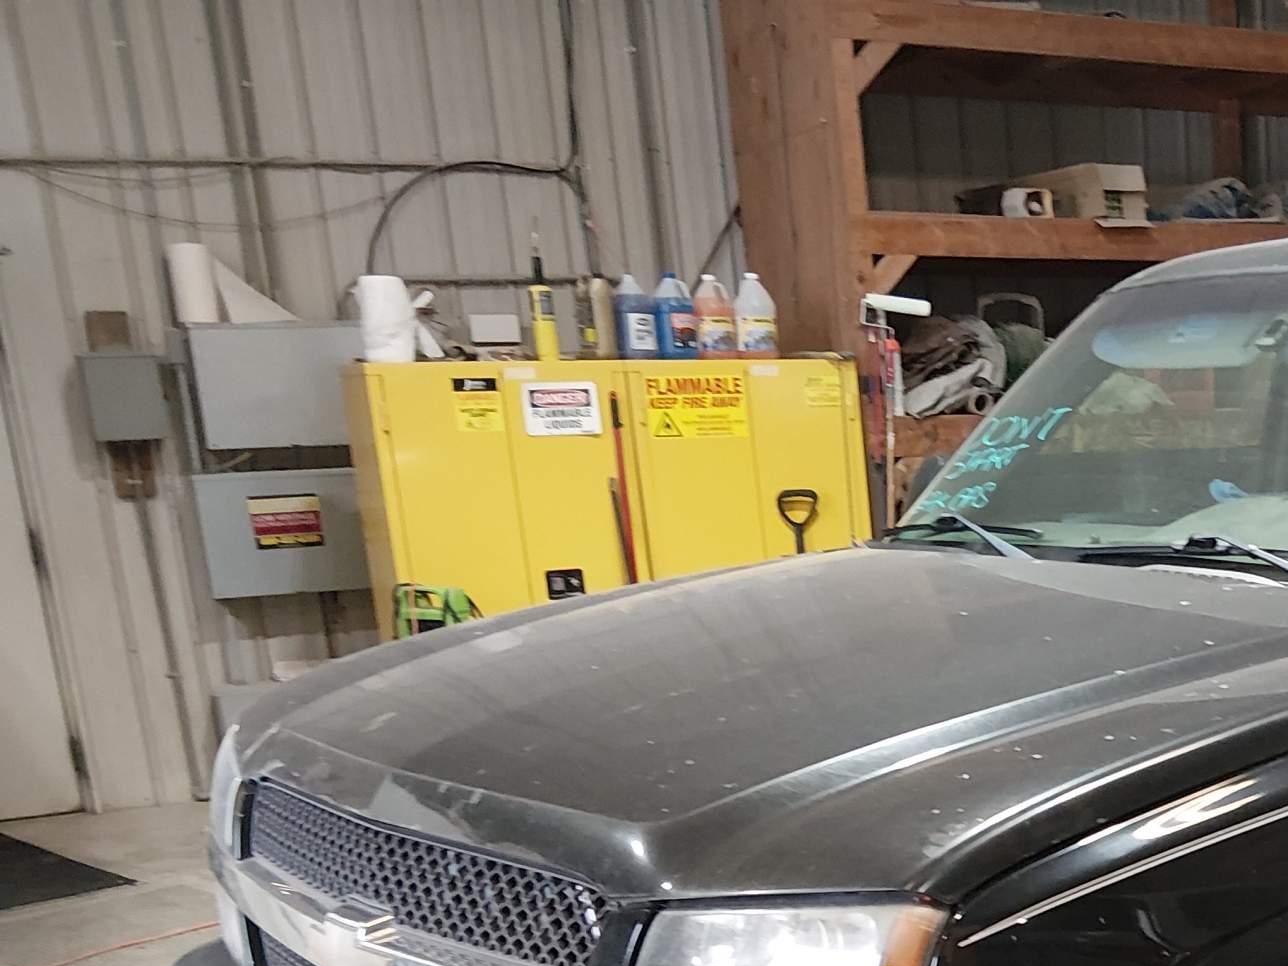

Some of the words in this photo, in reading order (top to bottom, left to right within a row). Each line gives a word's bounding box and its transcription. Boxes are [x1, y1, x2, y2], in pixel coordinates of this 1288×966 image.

[646, 378, 743, 395] FLAMMABLE
[533, 391, 591, 405] DANGER
[681, 396, 708, 408] FIRE
